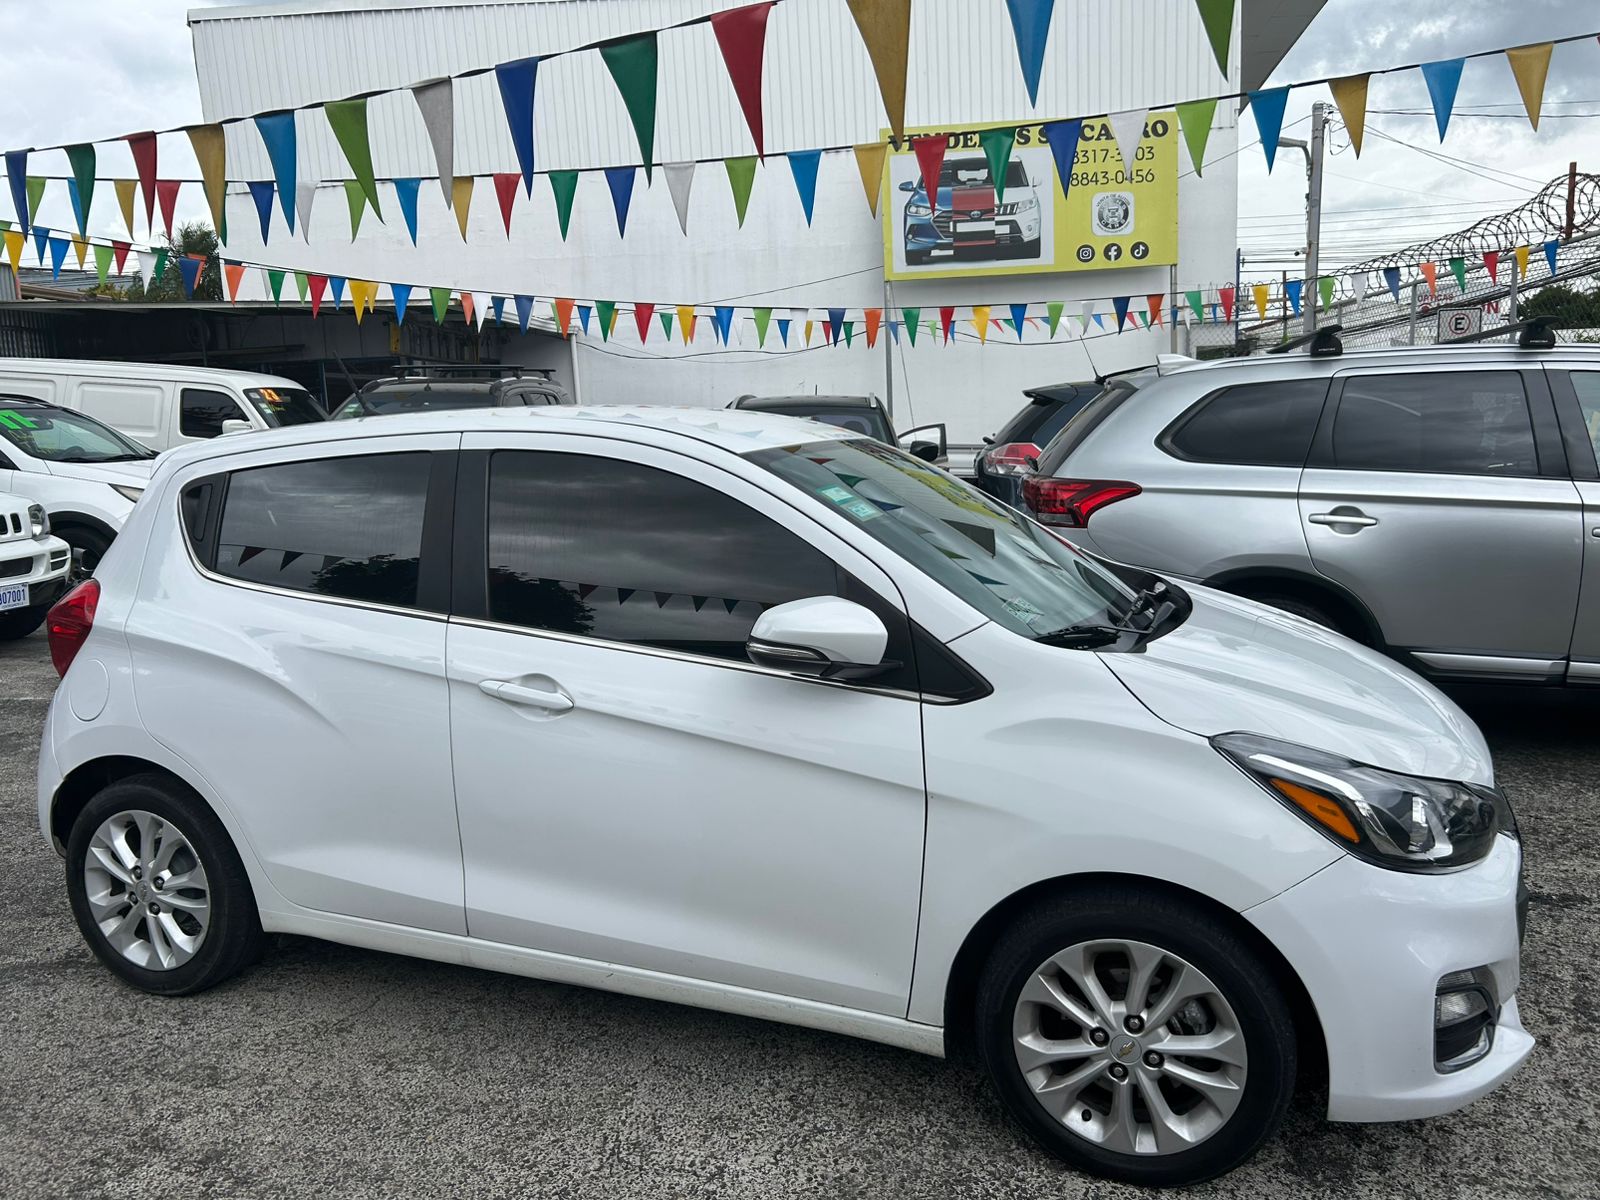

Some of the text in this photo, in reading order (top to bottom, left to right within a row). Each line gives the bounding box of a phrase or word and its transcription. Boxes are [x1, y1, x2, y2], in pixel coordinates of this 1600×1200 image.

[1079, 120, 1168, 142] CAO
[1073, 146, 1155, 164] 8317-303
[1454, 317, 1465, 330] E
